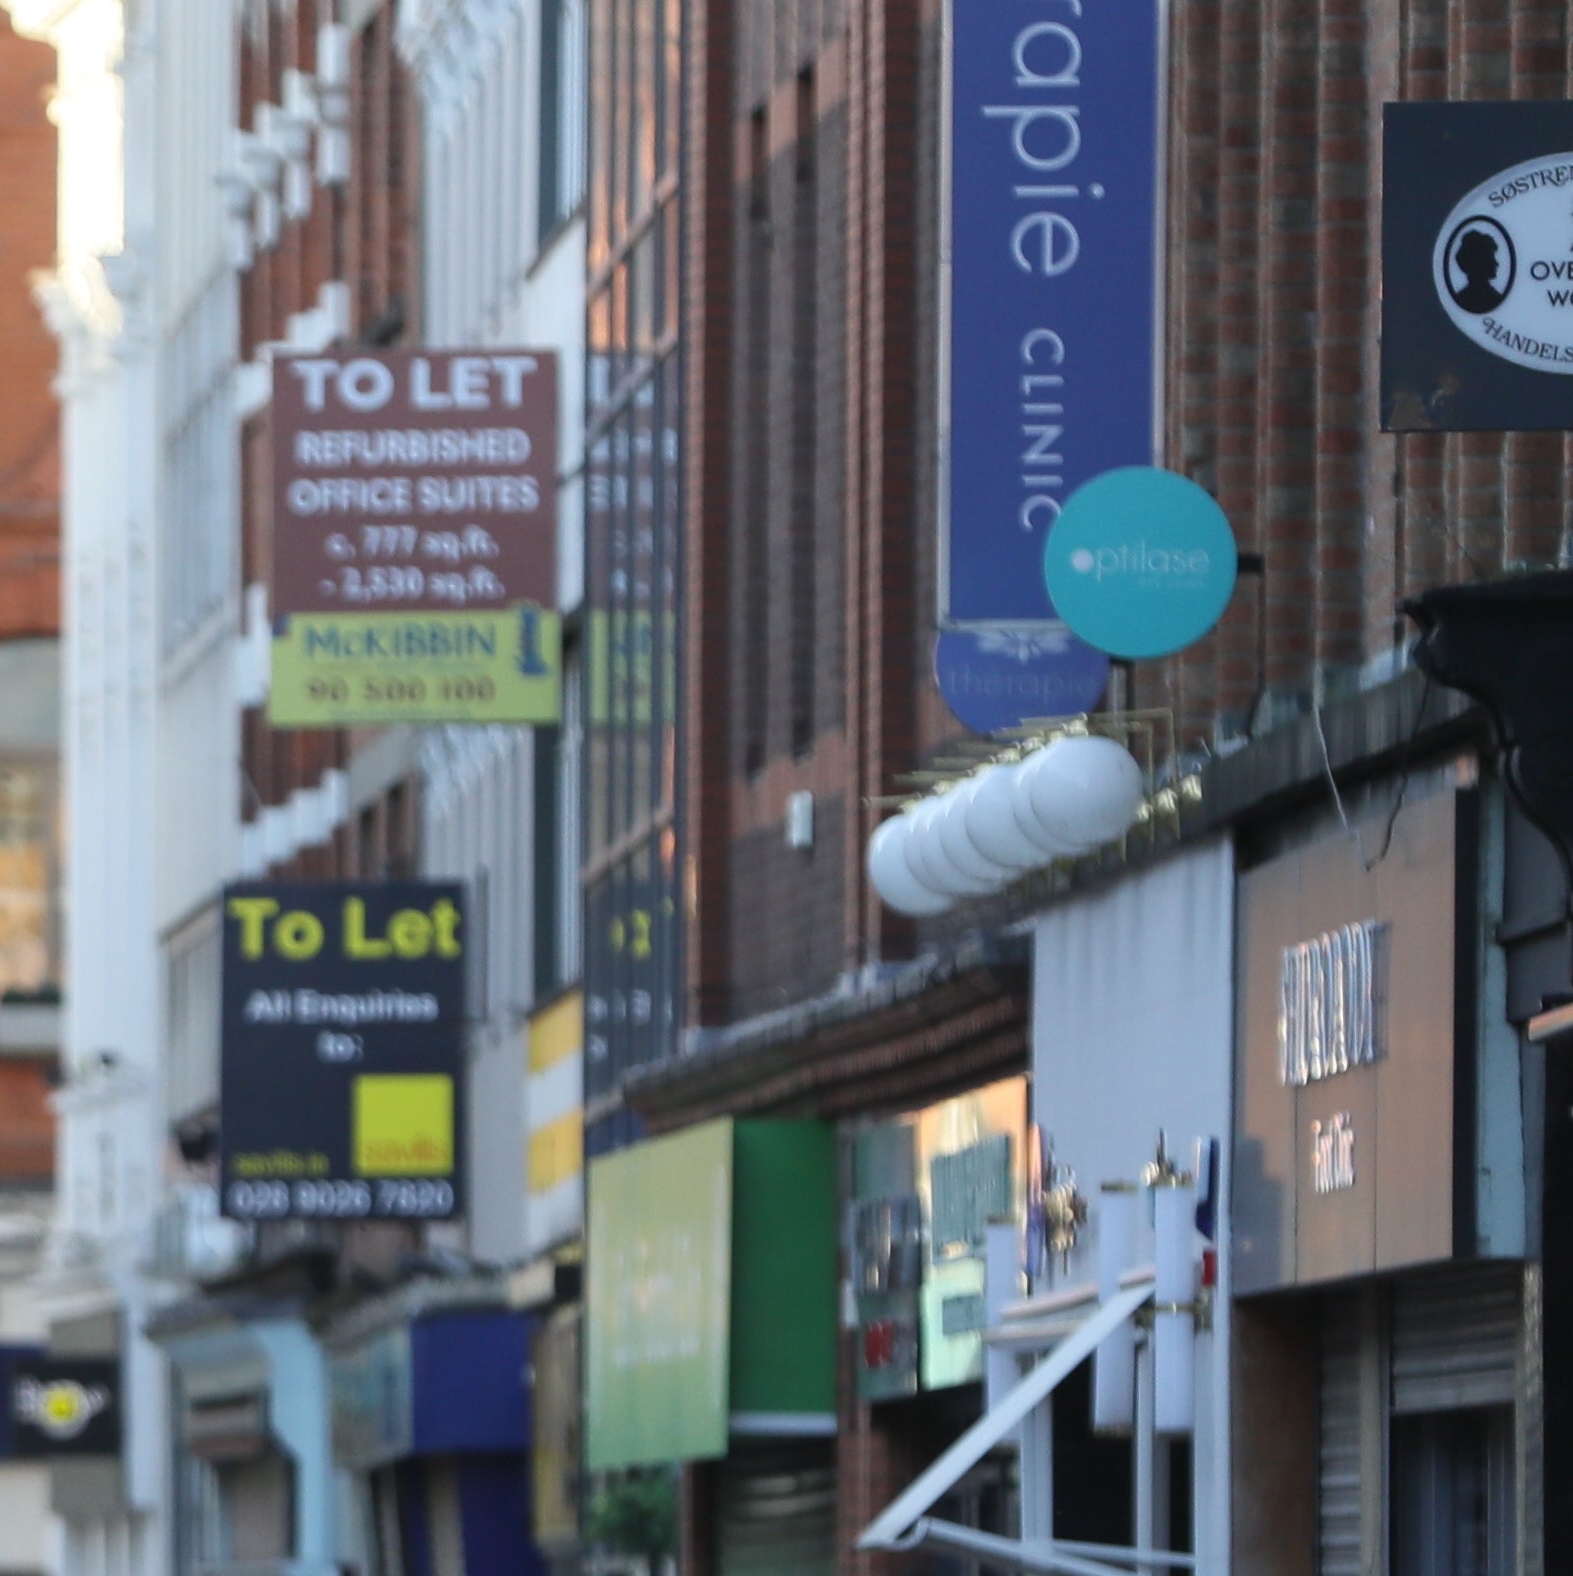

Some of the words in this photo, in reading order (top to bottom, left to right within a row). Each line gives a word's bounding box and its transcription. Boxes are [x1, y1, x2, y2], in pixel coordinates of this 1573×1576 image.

[291, 358, 394, 412] TO
[409, 357, 538, 410] LET
[295, 428, 531, 465] REFURBISHED
[1019, 328, 1065, 532] CLINIC
[288, 477, 413, 516] OFFICE
[418, 475, 540, 513] SUITES
[227, 897, 325, 961] To
[343, 896, 461, 960] Let
[245, 989, 291, 1023] All
[293, 988, 439, 1026] Enquiries
[228, 1179, 289, 1217] 028
